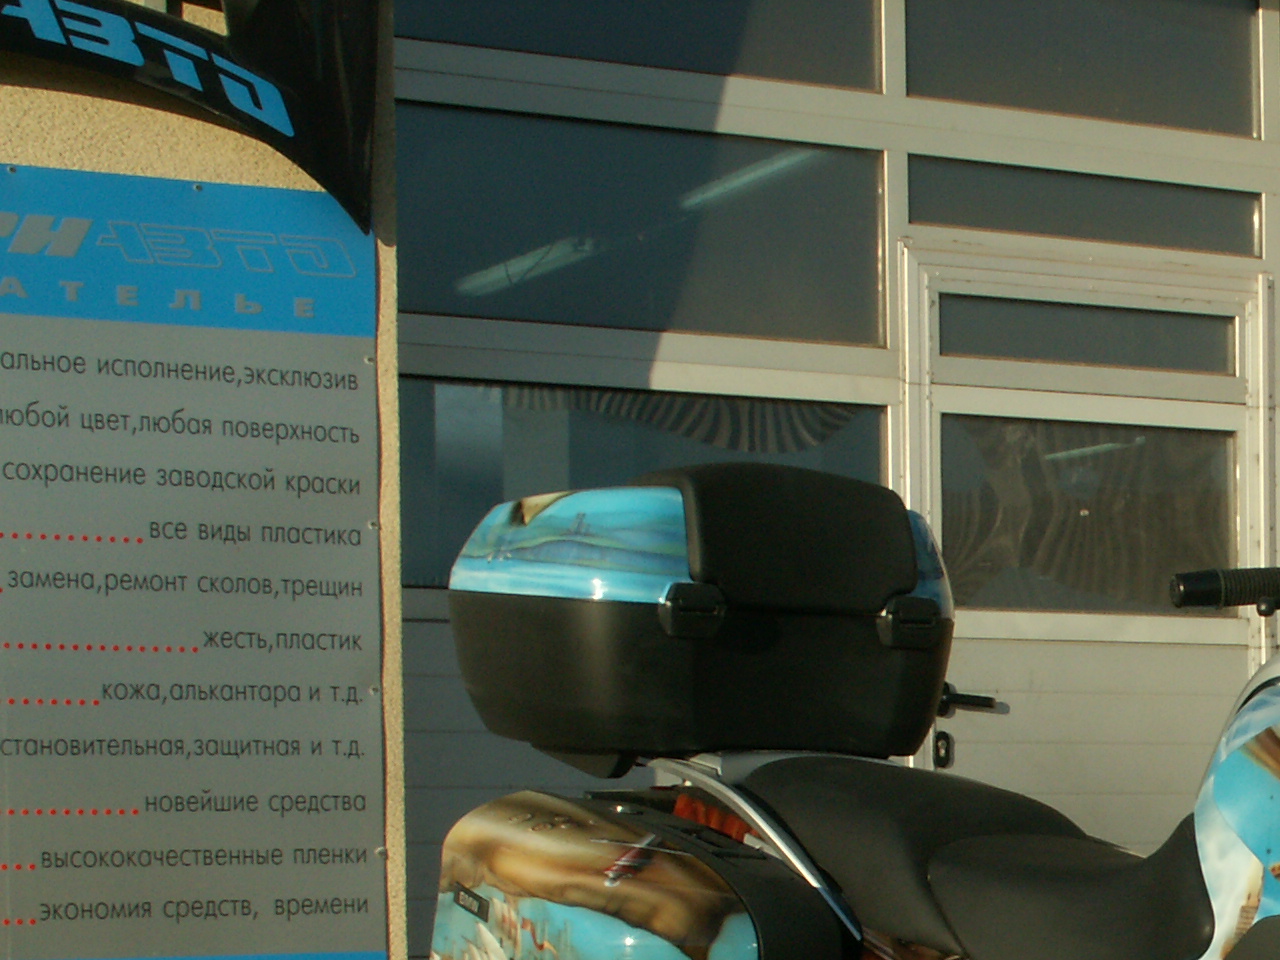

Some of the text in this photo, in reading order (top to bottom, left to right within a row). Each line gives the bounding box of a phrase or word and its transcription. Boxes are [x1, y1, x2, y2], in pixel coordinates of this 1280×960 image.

[0, 351, 87, 374] альное
[222, 419, 360, 446] поверхность
[1, 460, 361, 499] сохранение заводской краски
[149, 520, 362, 547] все виды пластика
[309, 685, 321, 703] и
[330, 684, 364, 706] т.д.
[310, 739, 322, 756] и
[331, 738, 365, 759] т.д.
[145, 789, 367, 818] новейшие средства
[41, 847, 367, 869] высококачественные пленки
[40, 896, 369, 924] экономия средств, времени
